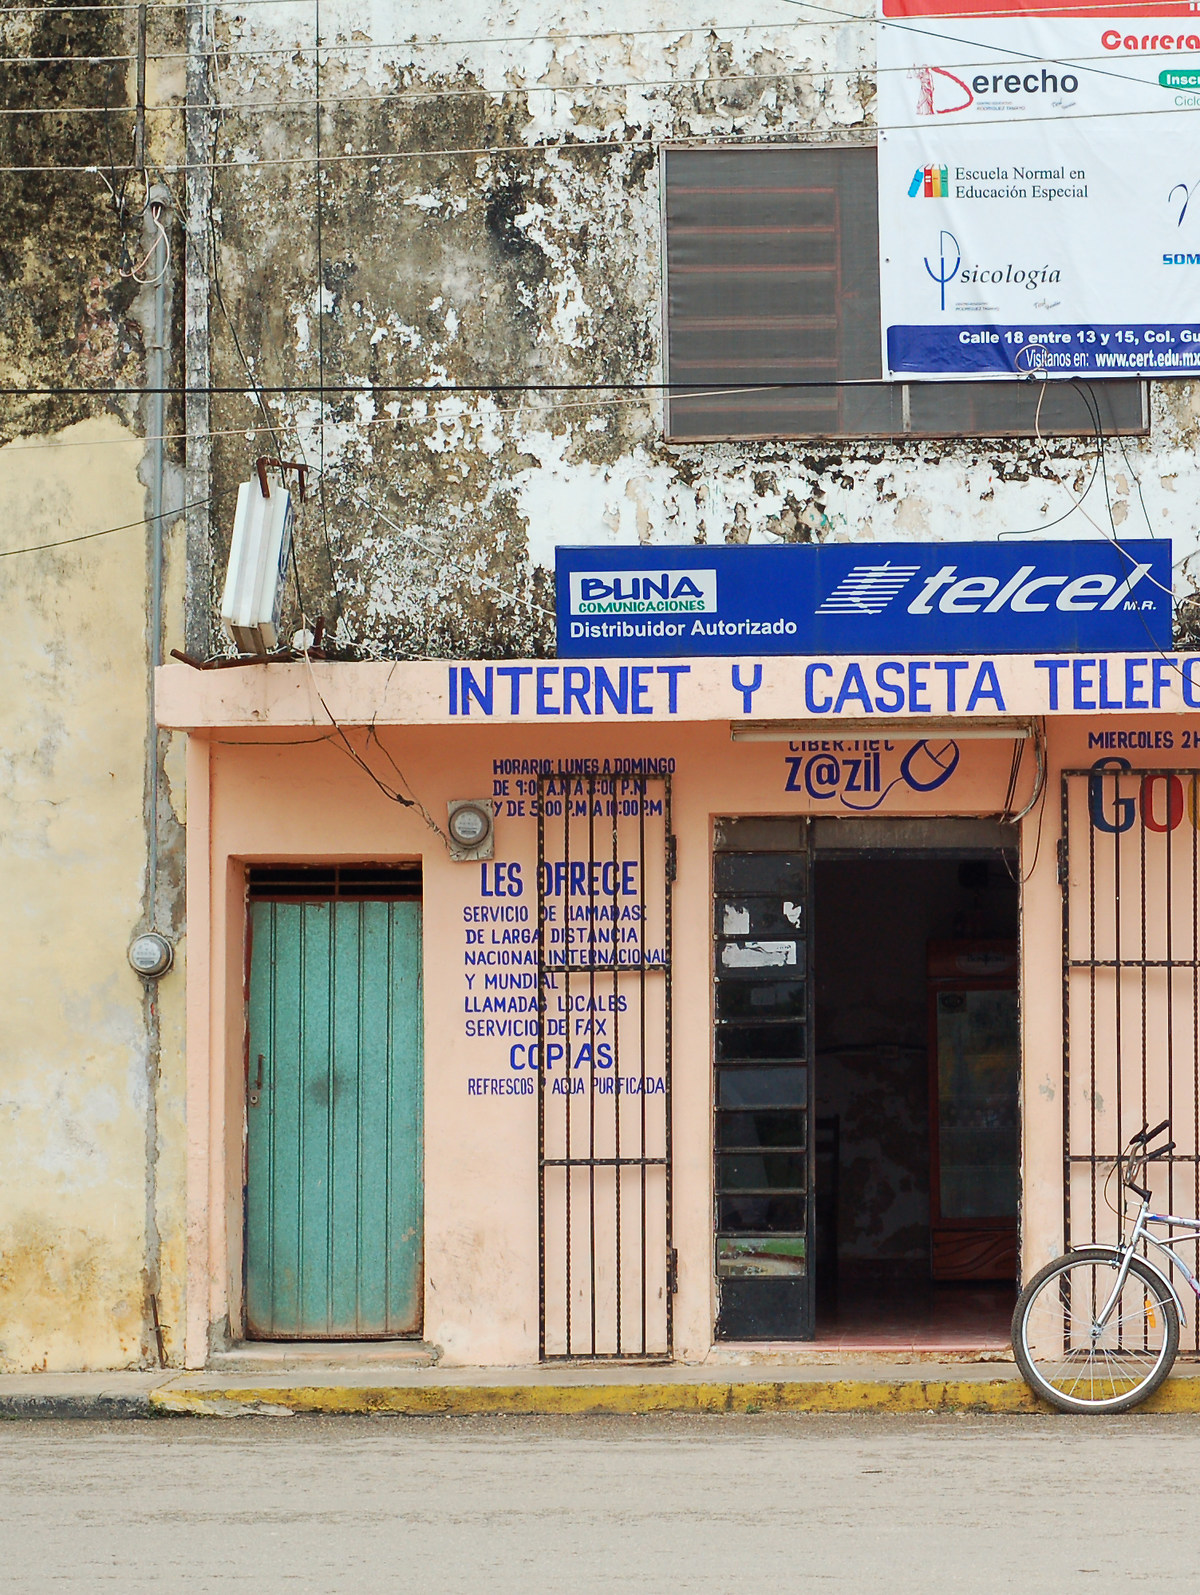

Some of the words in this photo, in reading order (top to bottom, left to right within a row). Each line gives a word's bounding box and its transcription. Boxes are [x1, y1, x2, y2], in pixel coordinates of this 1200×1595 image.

[955, 167, 1008, 181] Escuela
[1012, 167, 1065, 180] Normal
[1069, 170, 1086, 180] en
[955, 185, 1028, 198] Educación
[1031, 185, 1089, 201] Especial
[958, 330, 1000, 344] Calle
[1004, 330, 1024, 344] 18
[1028, 332, 1072, 344] entre
[1076, 330, 1096, 344] 13
[1100, 333, 1111, 346] y
[1115, 330, 1140, 346] 15,
[1143, 330, 1176, 344] Col.
[1073, 352, 1089, 367] en:
[1095, 349, 1200, 368] www.cert.edu.mx
[581, 573, 704, 601] BUNA
[905, 563, 1152, 615] telcel
[1123, 601, 1157, 612] M.R.
[578, 600, 706, 613] COMUNICACIONES
[570, 619, 687, 638] Distribuidor
[692, 617, 797, 637] Autorizado
[449, 665, 691, 715] INTERNET
[731, 664, 763, 714] Y
[803, 660, 1006, 714] CASETA
[1088, 731, 1174, 749] MIERCOLES
[558, 758, 599, 774] LUNES
[602, 758, 612, 774] A
[614, 757, 676, 774] DOMINGO
[481, 862, 524, 897] LES
[536, 861, 638, 897] OFRECE
[463, 905, 529, 922] SERVICIO
[465, 929, 485, 944] DE
[491, 929, 541, 944] LARGA
[550, 928, 638, 943] DISTANCIA
[464, 951, 540, 966] NACIONAL
[465, 974, 476, 990] Y
[558, 995, 628, 1012] LOCALES
[465, 1019, 539, 1036] SERVICIO
[546, 1019, 567, 1036] DE
[575, 1018, 607, 1036] FAX
[468, 1078, 534, 1095] REFRESCOS
